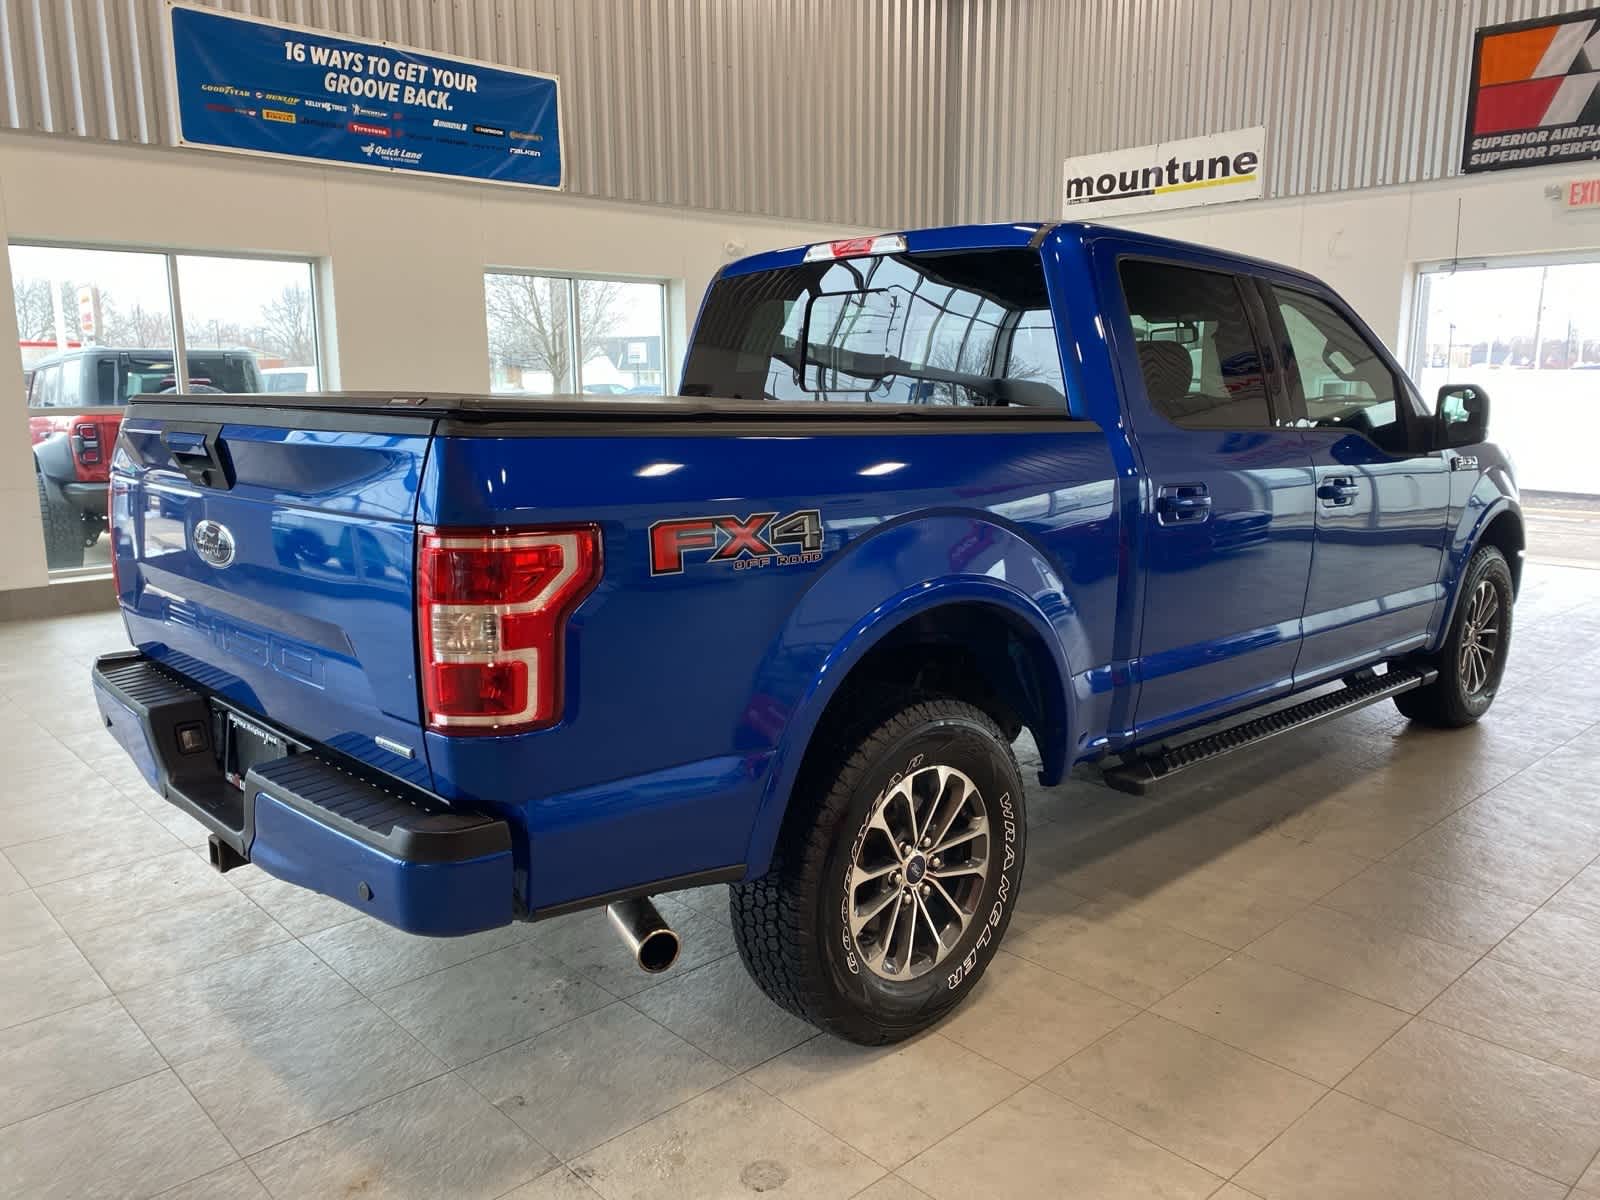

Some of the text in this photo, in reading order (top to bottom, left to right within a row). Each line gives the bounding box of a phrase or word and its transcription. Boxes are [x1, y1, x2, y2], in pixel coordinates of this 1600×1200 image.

[285, 41, 478, 93] 16 WAYS TO GET YOUR
[202, 84, 251, 97] GOODYEAR
[324, 72, 454, 111] GROOVE BACK.
[352, 124, 388, 136] Firestone
[1471, 130, 1549, 150] SUPERIOR
[374, 146, 423, 159] Quick Lane
[1469, 146, 1548, 165] SUPERIOR
[1066, 151, 1259, 199] mountune
[648, 508, 825, 577] FX4
[733, 552, 823, 571] OFF ROAD
[947, 791, 1017, 990] WRANGLER
